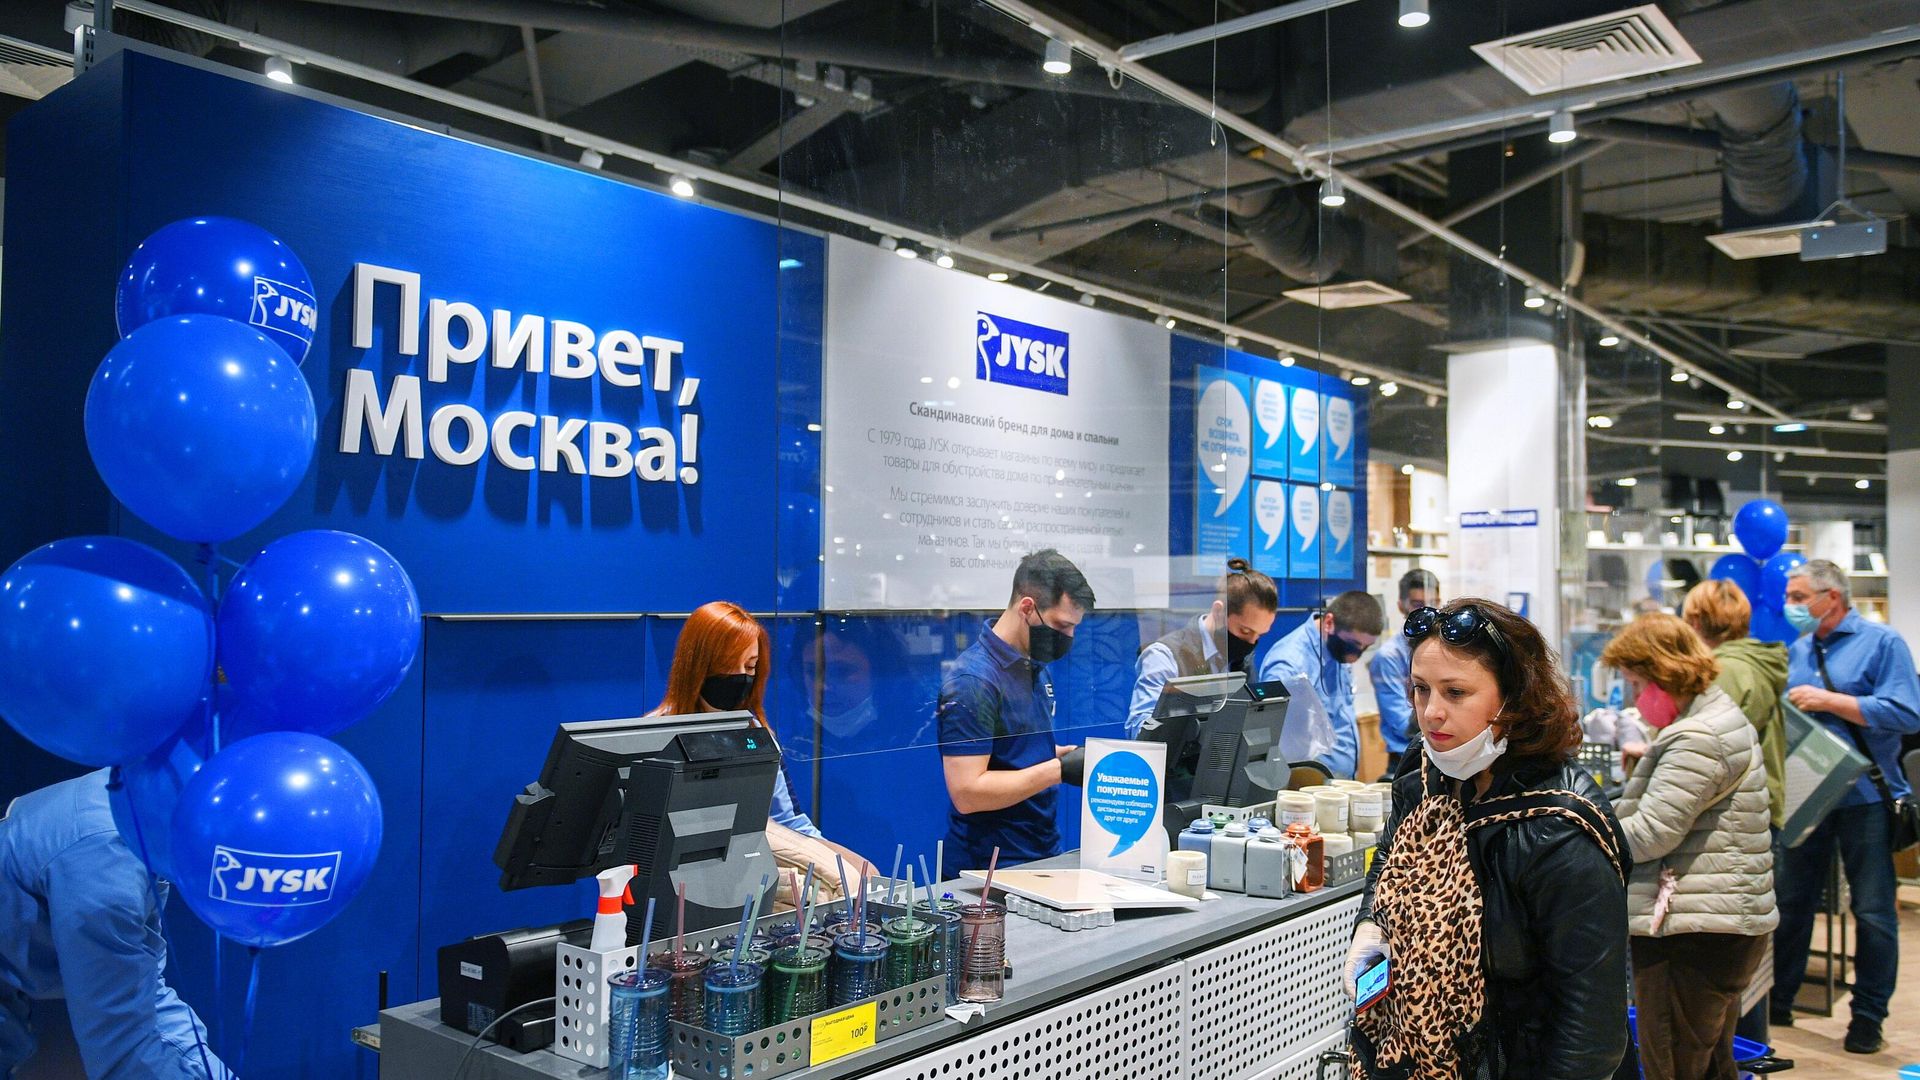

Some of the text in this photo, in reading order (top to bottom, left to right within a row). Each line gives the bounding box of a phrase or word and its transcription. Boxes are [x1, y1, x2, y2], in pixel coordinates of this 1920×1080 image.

[353, 262, 700, 406] Привет,
[995, 333, 1066, 379] JYSK
[339, 368, 699, 485] Москва!
[909, 402, 1119, 446] Скандинавский бренд для дома и спальни
[867, 427, 876, 443] С
[880, 430, 902, 446] 1979
[904, 436, 926, 452] года
[928, 437, 950, 453] JYSK
[951, 443, 998, 460] открывает
[883, 455, 919, 472] товары
[922, 460, 940, 472] для
[942, 459, 1005, 480] обустройства
[890, 486, 907, 502] Мы
[910, 491, 963, 507] стремимся
[966, 496, 1012, 513] заслужить
[900, 512, 961, 529] сотрудников
[971, 535, 985, 548] Так
[950, 557, 966, 569] вас
[1096, 772, 1150, 786] Уважаемые
[1096, 785, 1149, 797] покупатели
[235, 866, 332, 893] JYSK
